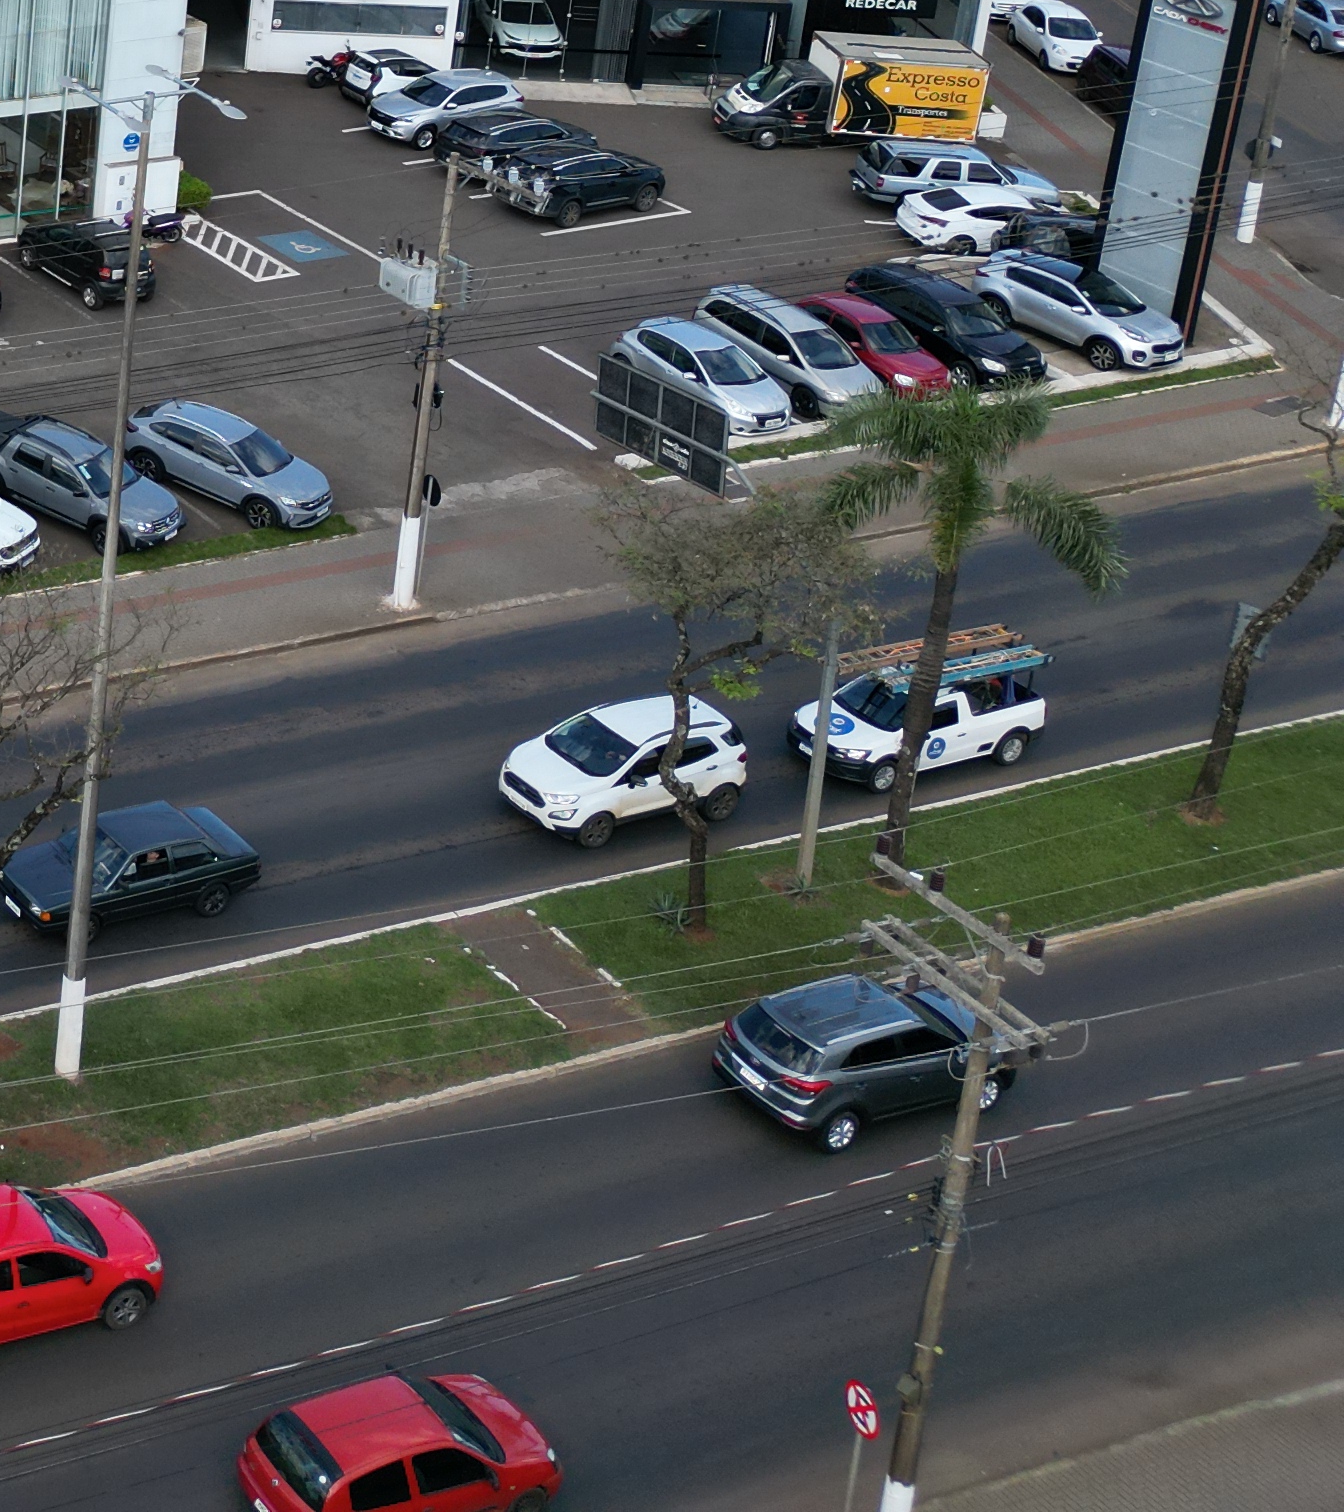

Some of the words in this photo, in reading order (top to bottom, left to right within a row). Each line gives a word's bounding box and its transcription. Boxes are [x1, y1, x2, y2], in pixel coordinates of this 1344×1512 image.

[885, 66, 981, 89] Expresso
[914, 86, 968, 104] Costa
[897, 105, 949, 118] Transportes
